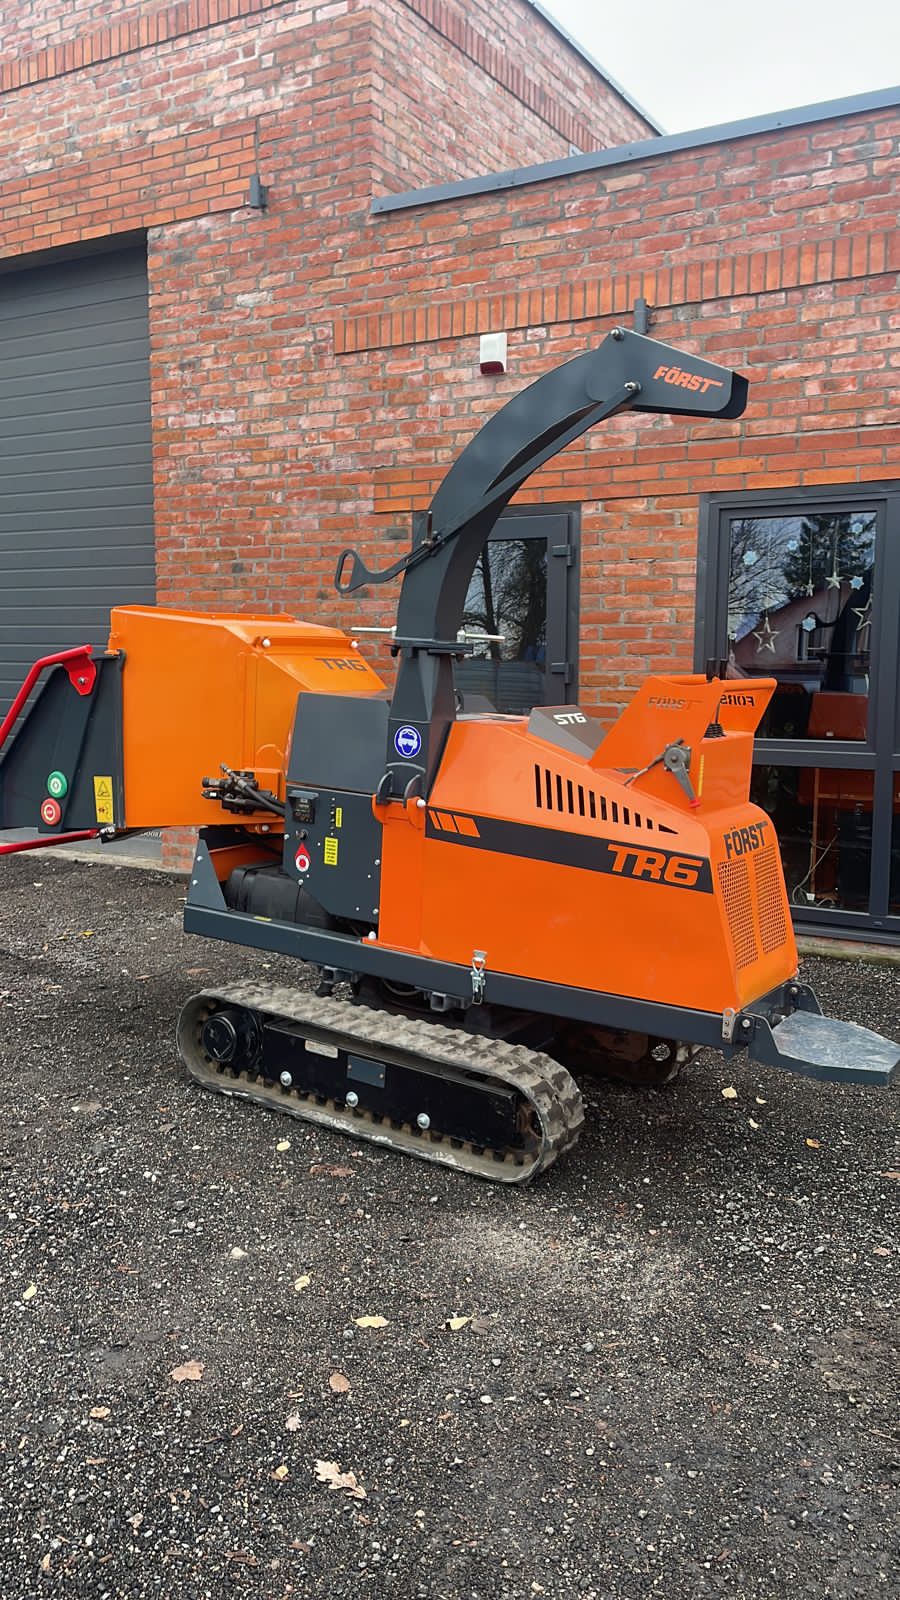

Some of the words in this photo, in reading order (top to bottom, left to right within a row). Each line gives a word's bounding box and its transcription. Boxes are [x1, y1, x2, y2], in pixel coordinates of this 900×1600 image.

[653, 365, 724, 393] FÖRST
[314, 657, 368, 672] TR6
[553, 712, 587, 725] ST6
[723, 820, 768, 860] FÖRST
[607, 843, 703, 887] TR6
